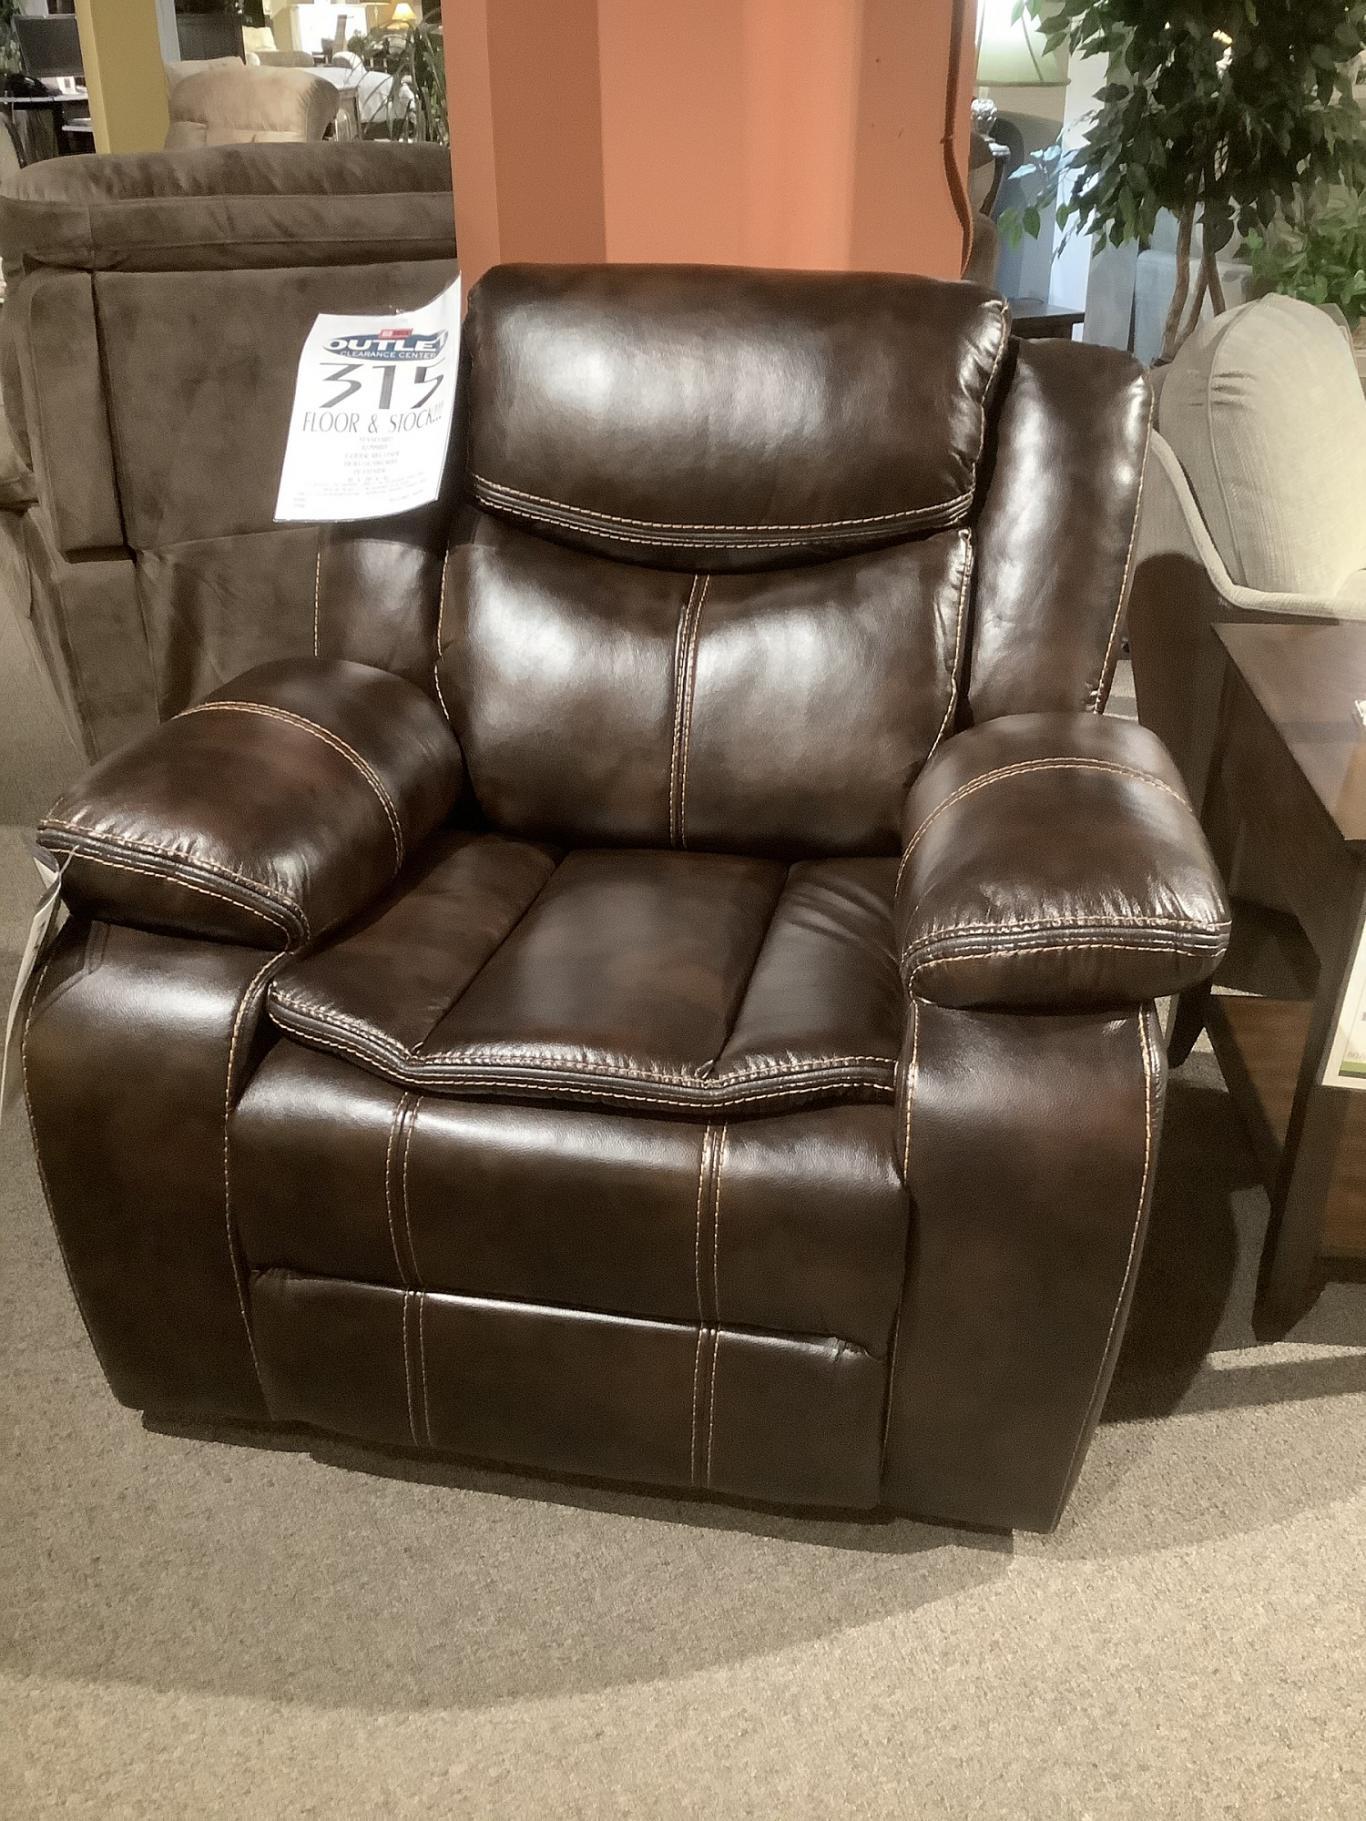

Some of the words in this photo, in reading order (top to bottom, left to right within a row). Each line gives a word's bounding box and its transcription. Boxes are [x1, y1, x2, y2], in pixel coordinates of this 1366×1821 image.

[340, 350, 397, 358] CLEARANCE
[398, 350, 437, 359] CENTER
[318, 357, 446, 410] 315
[303, 411, 360, 433] FLOOR
[367, 412, 379, 434] &
